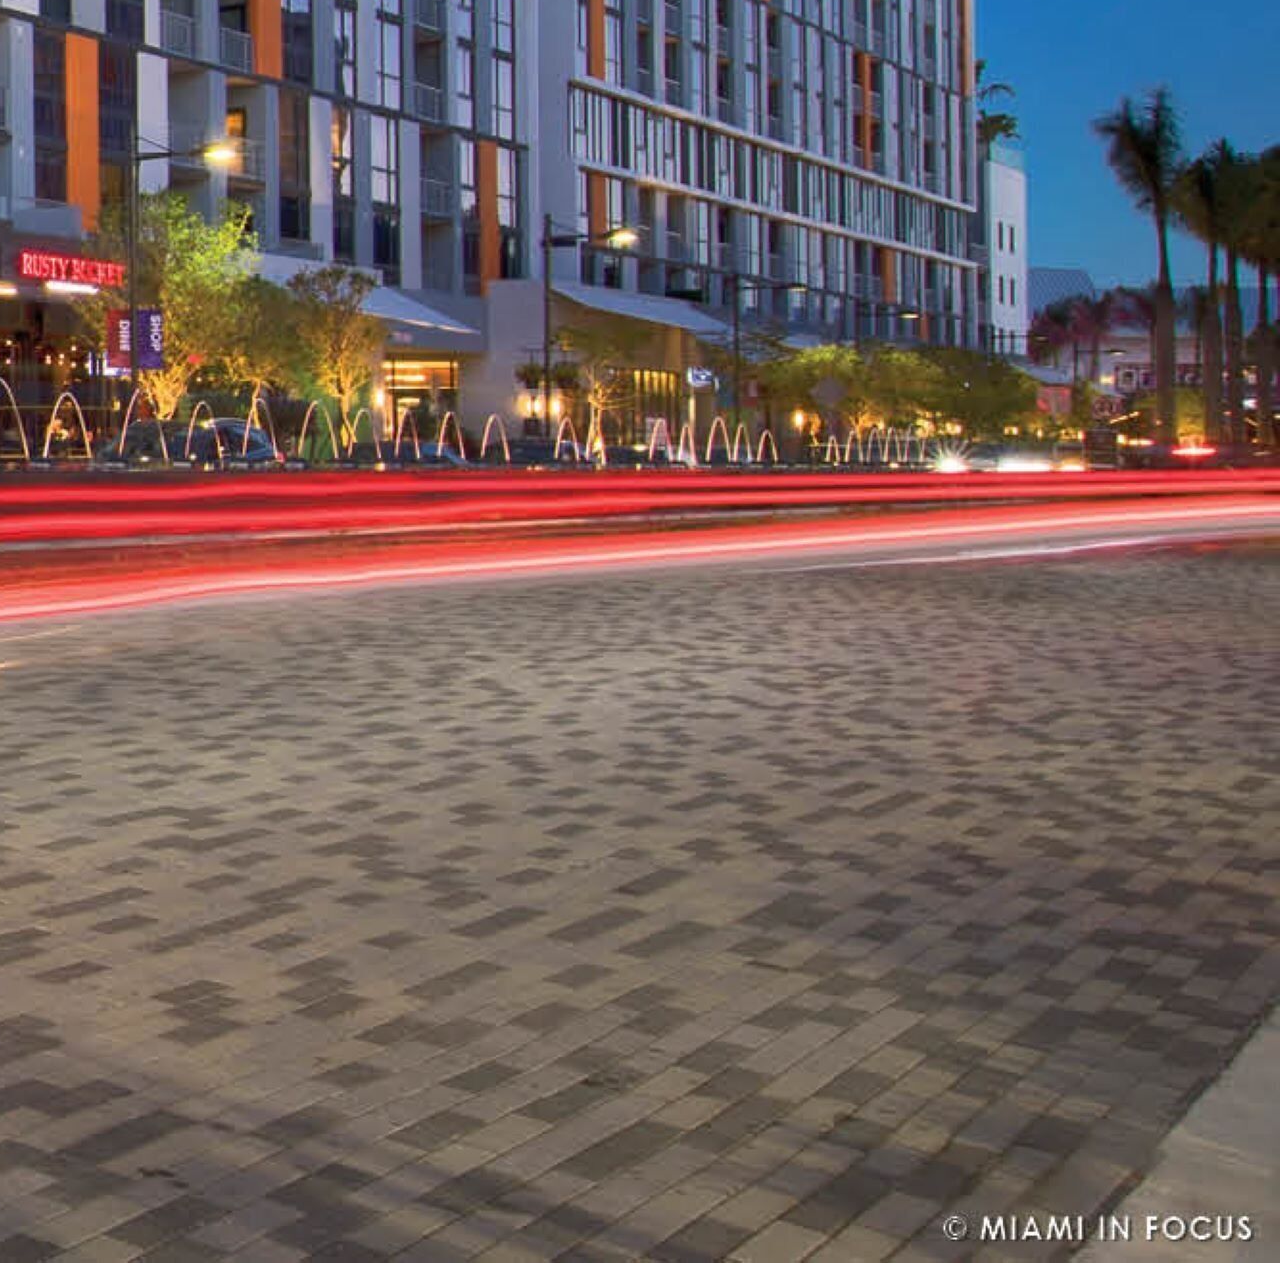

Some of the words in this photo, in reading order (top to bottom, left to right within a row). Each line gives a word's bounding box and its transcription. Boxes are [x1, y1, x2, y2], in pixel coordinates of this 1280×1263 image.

[22, 252, 69, 281] RUSTY
[70, 259, 126, 287] BUCKET
[119, 319, 131, 351] DINE
[150, 315, 162, 352] SHOP
